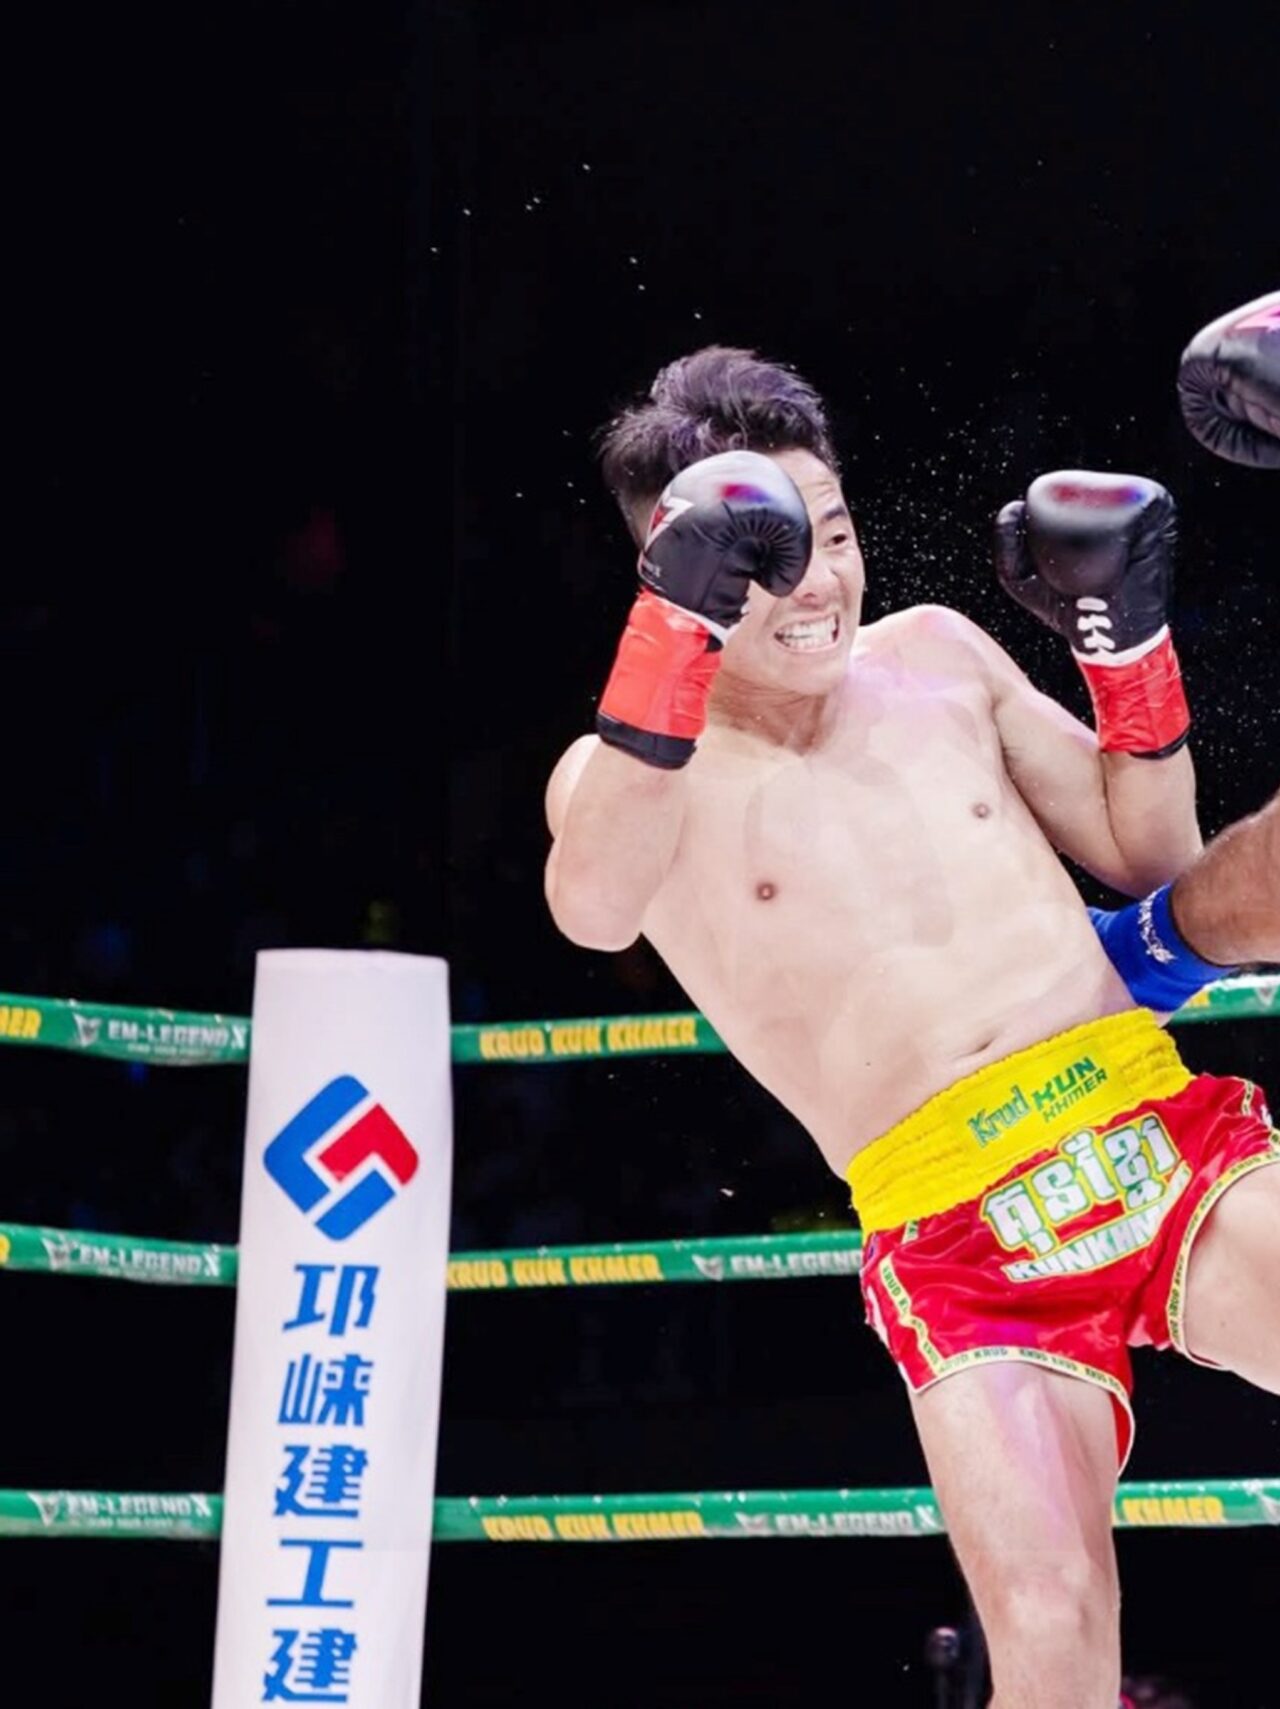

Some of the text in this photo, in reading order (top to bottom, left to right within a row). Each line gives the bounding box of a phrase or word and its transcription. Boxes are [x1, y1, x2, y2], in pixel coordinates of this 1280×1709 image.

[108, 1020, 229, 1048] EM-LEGEND
[1032, 1056, 1096, 1110] KUN
[1121, 1496, 1225, 1524] KHMER
